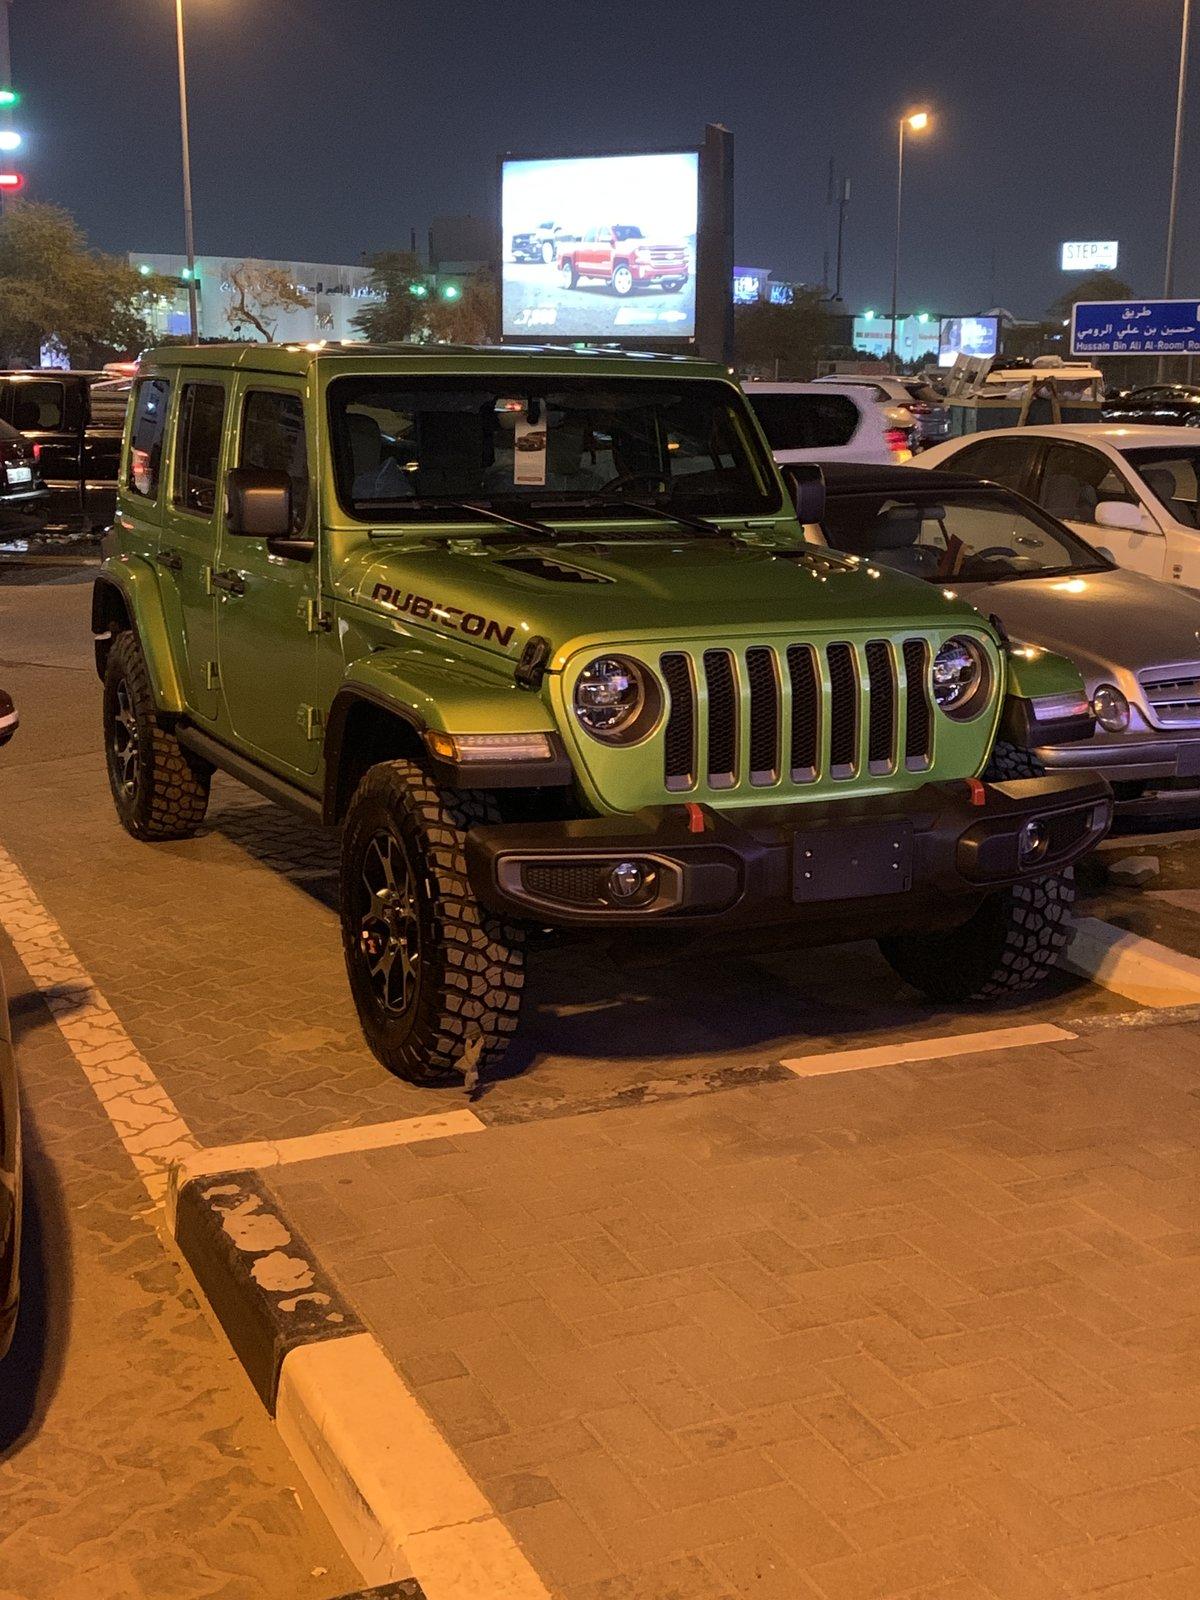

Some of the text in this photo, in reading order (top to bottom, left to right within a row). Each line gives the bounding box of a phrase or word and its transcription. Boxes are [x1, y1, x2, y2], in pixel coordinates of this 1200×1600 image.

[1121, 306, 1152, 319] طريق
[1077, 323, 1196, 340] حسين بن علي الرومي
[1076, 341, 1111, 351] Hussain
[1113, 341, 1127, 351] Bin
[371, 582, 516, 647] RUBICON
